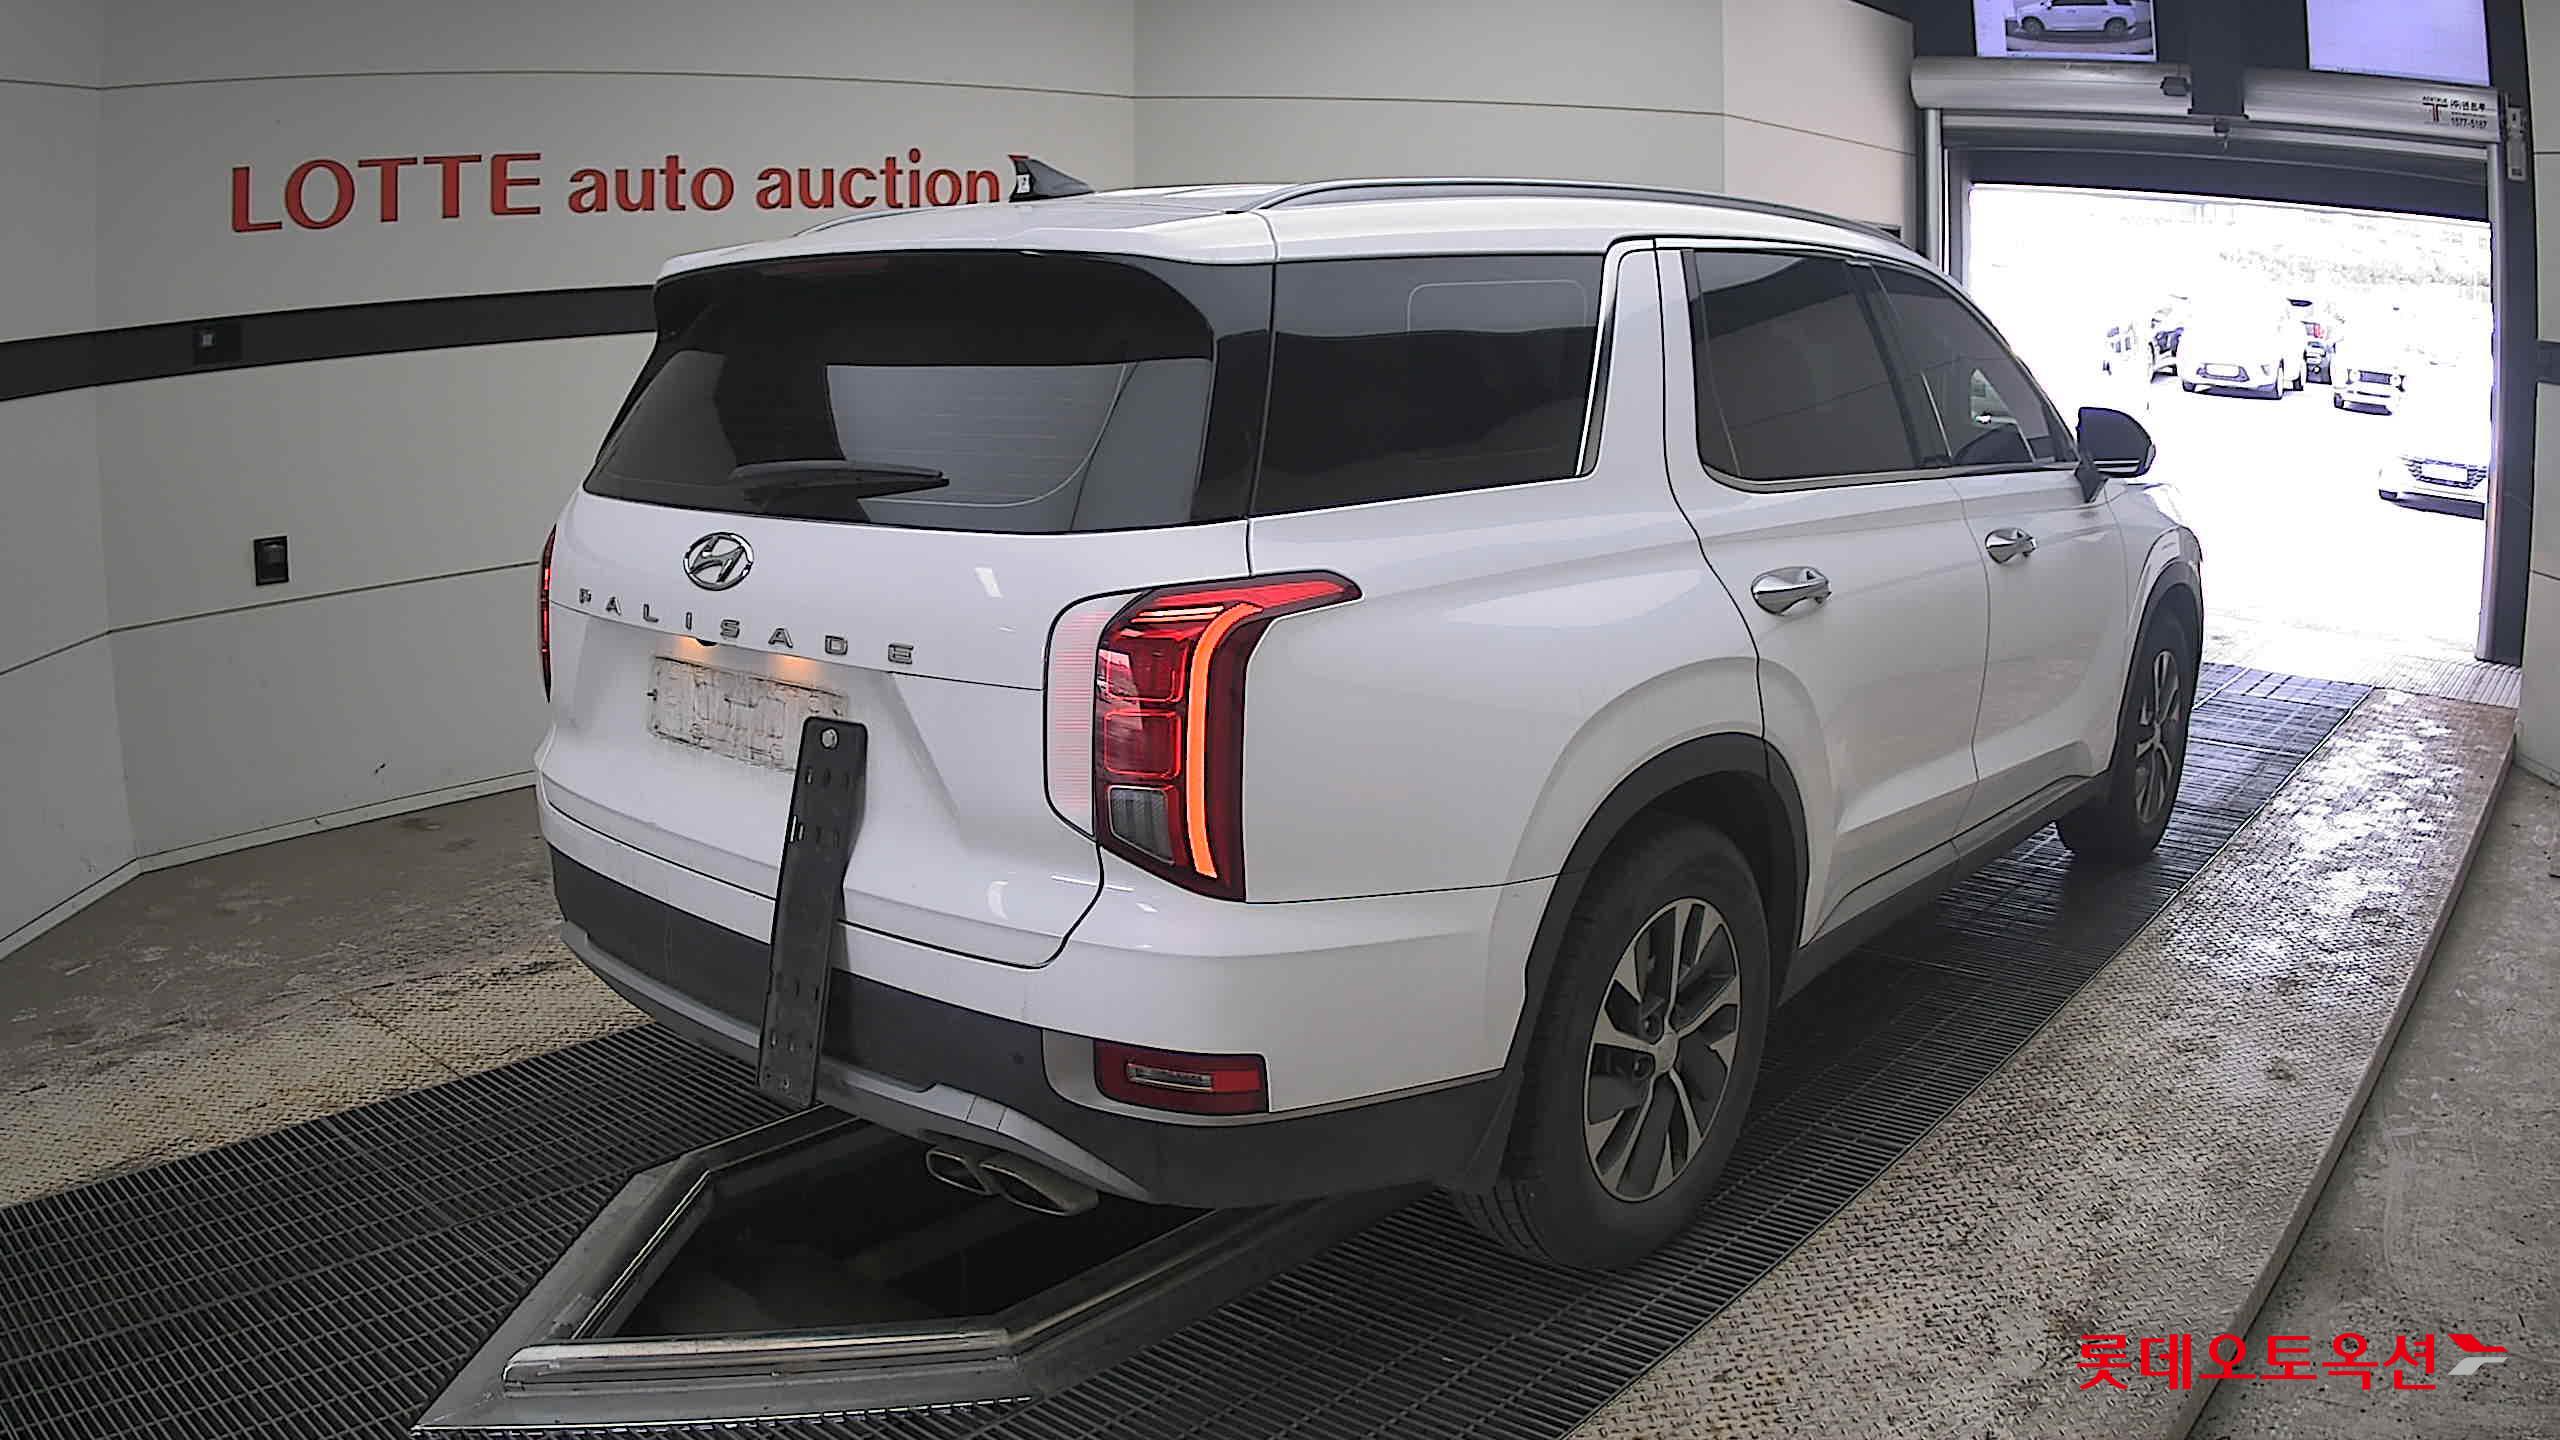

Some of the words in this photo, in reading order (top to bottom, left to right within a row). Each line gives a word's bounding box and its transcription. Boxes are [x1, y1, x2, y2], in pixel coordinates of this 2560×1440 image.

[230, 152, 542, 233] LOTTE
[568, 155, 734, 212] auto
[757, 147, 1000, 210] auction
[578, 587, 915, 665] PALISADE
